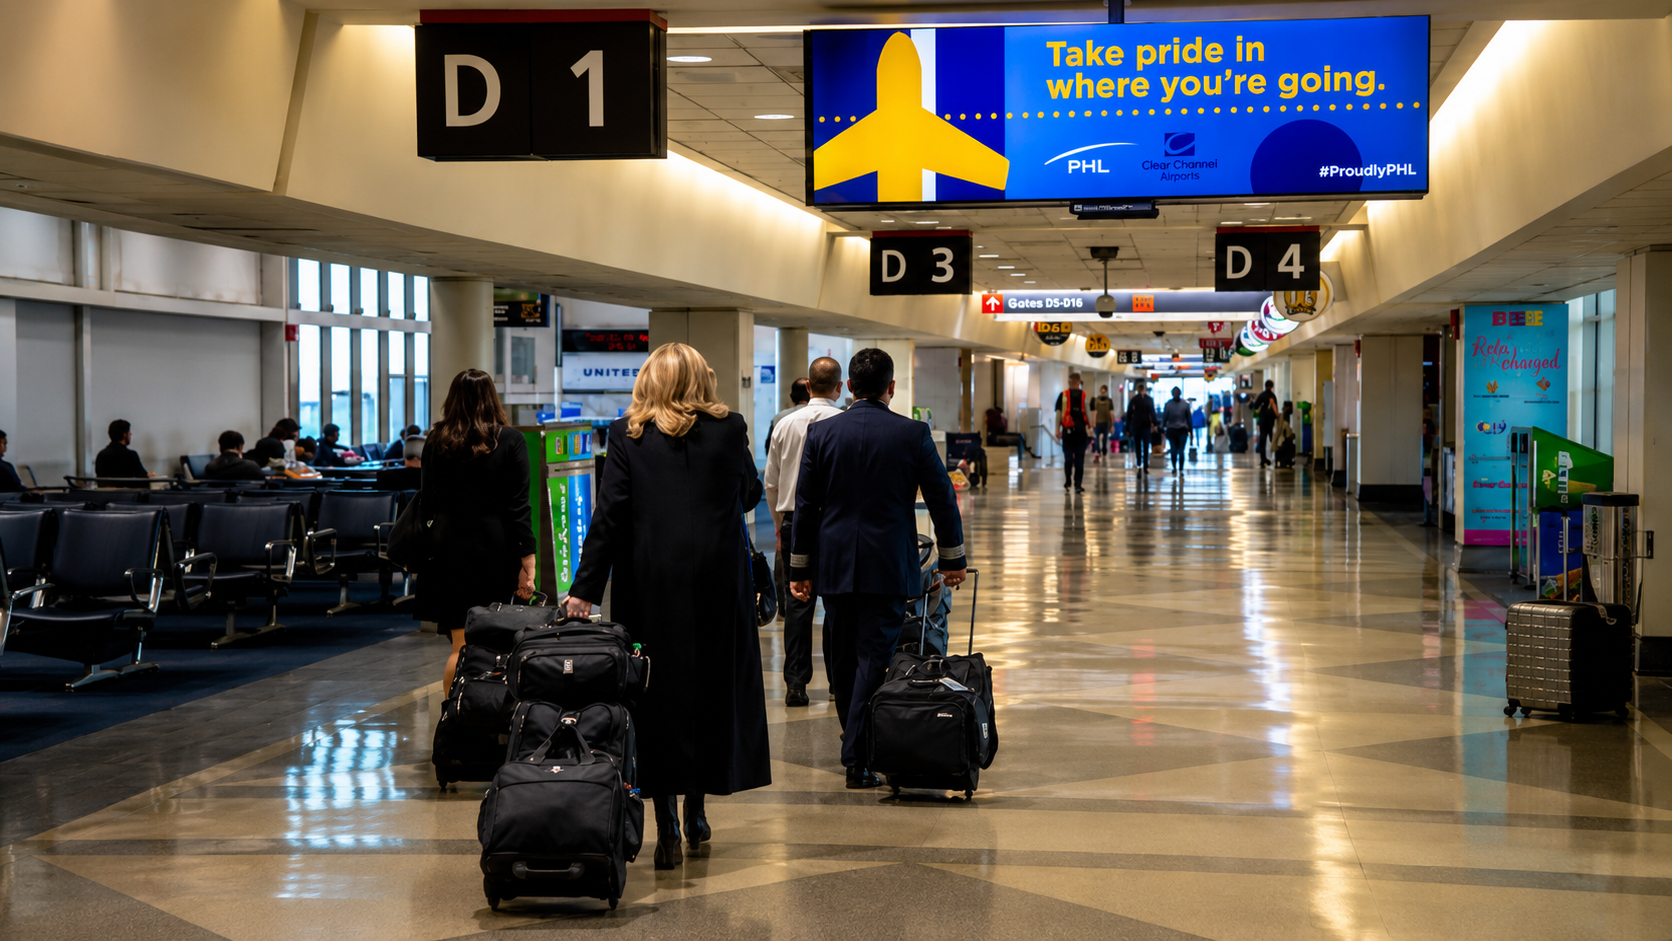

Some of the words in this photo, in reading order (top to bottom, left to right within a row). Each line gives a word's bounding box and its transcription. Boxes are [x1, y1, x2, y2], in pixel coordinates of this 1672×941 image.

[1046, 39, 1125, 67] Take
[1136, 36, 1224, 71] pride
[1236, 35, 1265, 63] in
[444, 55, 501, 127] D
[570, 50, 604, 127] 1
[1046, 72, 1150, 99] where
[1160, 68, 1267, 103] you're
[1278, 65, 1386, 98] going.
[1068, 159, 1110, 174] PHL
[1142, 160, 1171, 171] Clear
[1173, 158, 1218, 169] Channel
[1160, 172, 1200, 182] Airports
[1319, 163, 1417, 179] #ProudlyPHL
[882, 249, 906, 283] D
[931, 247, 954, 283] 3
[1226, 245, 1252, 279] D
[1277, 243, 1306, 279] 4
[1008, 297, 1044, 309] Gates
